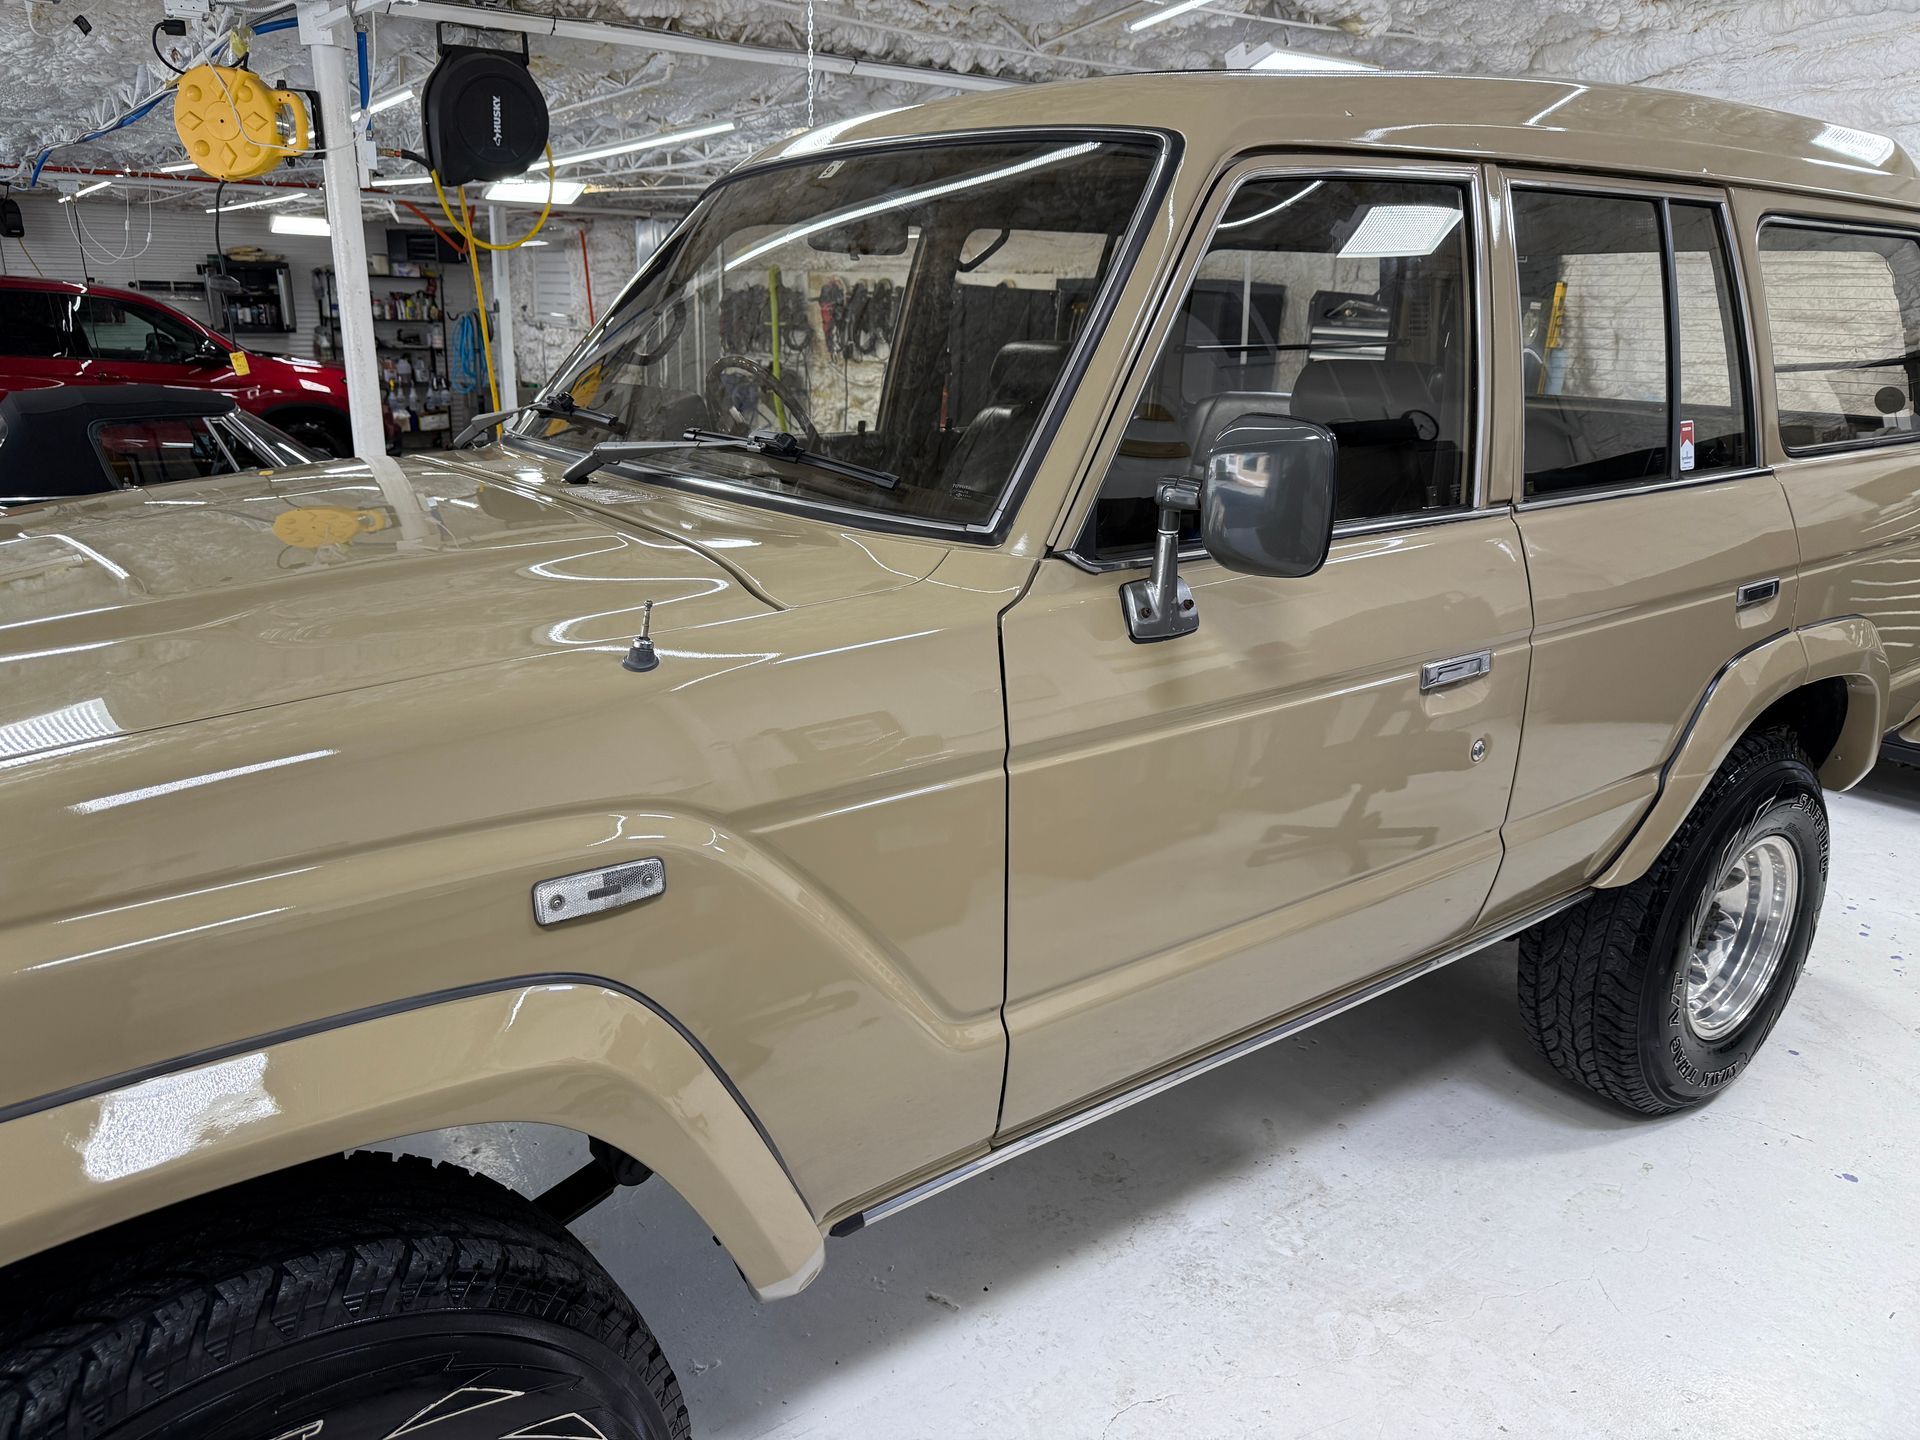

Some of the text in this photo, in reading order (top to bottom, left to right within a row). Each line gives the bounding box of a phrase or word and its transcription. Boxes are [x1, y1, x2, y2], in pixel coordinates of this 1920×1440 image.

[492, 95, 503, 135] HUSKY
[1669, 1036, 1699, 1085] TRAC
[1698, 1060, 1739, 1088] MAX
